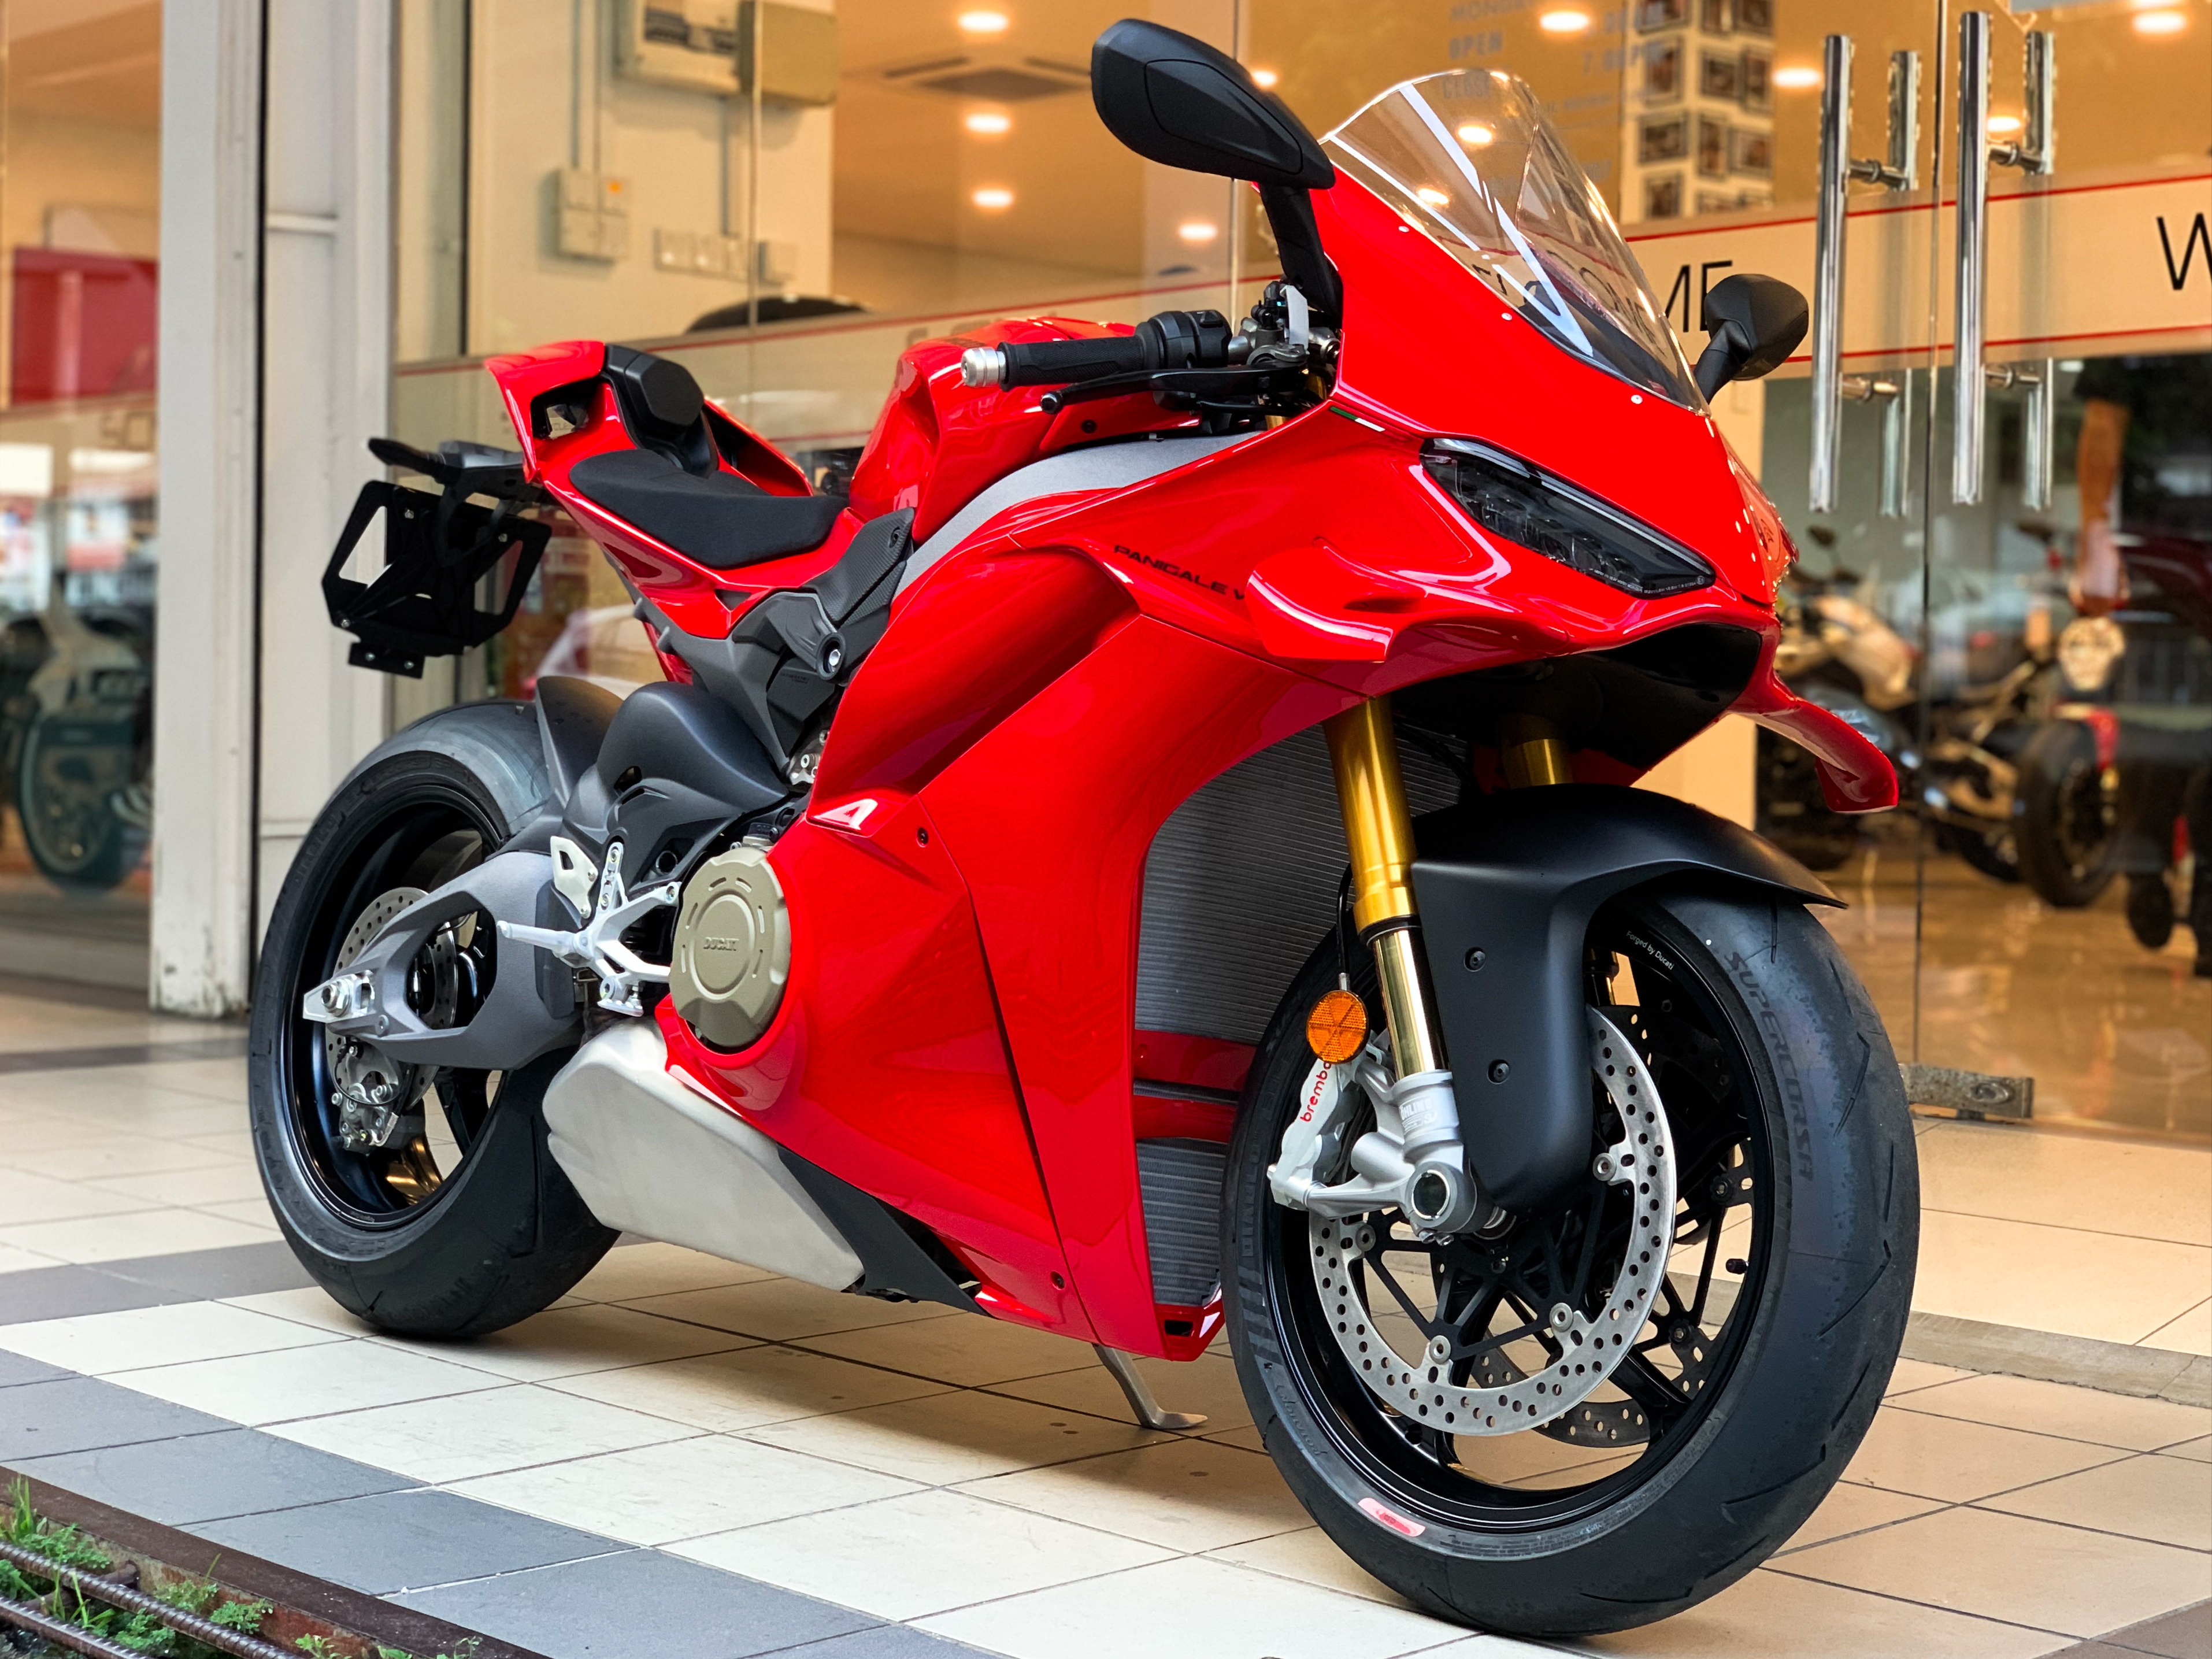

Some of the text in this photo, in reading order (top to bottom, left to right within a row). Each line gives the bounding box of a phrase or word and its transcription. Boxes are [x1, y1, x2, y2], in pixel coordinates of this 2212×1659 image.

[1114, 544, 1229, 595] PANIGALE
[703, 936, 739, 951] DUCATI
[1626, 930, 1675, 971] Forged by Ducati
[1724, 951, 1814, 1182] SUPERCORSA
[1299, 1062, 1332, 1123] brembo
